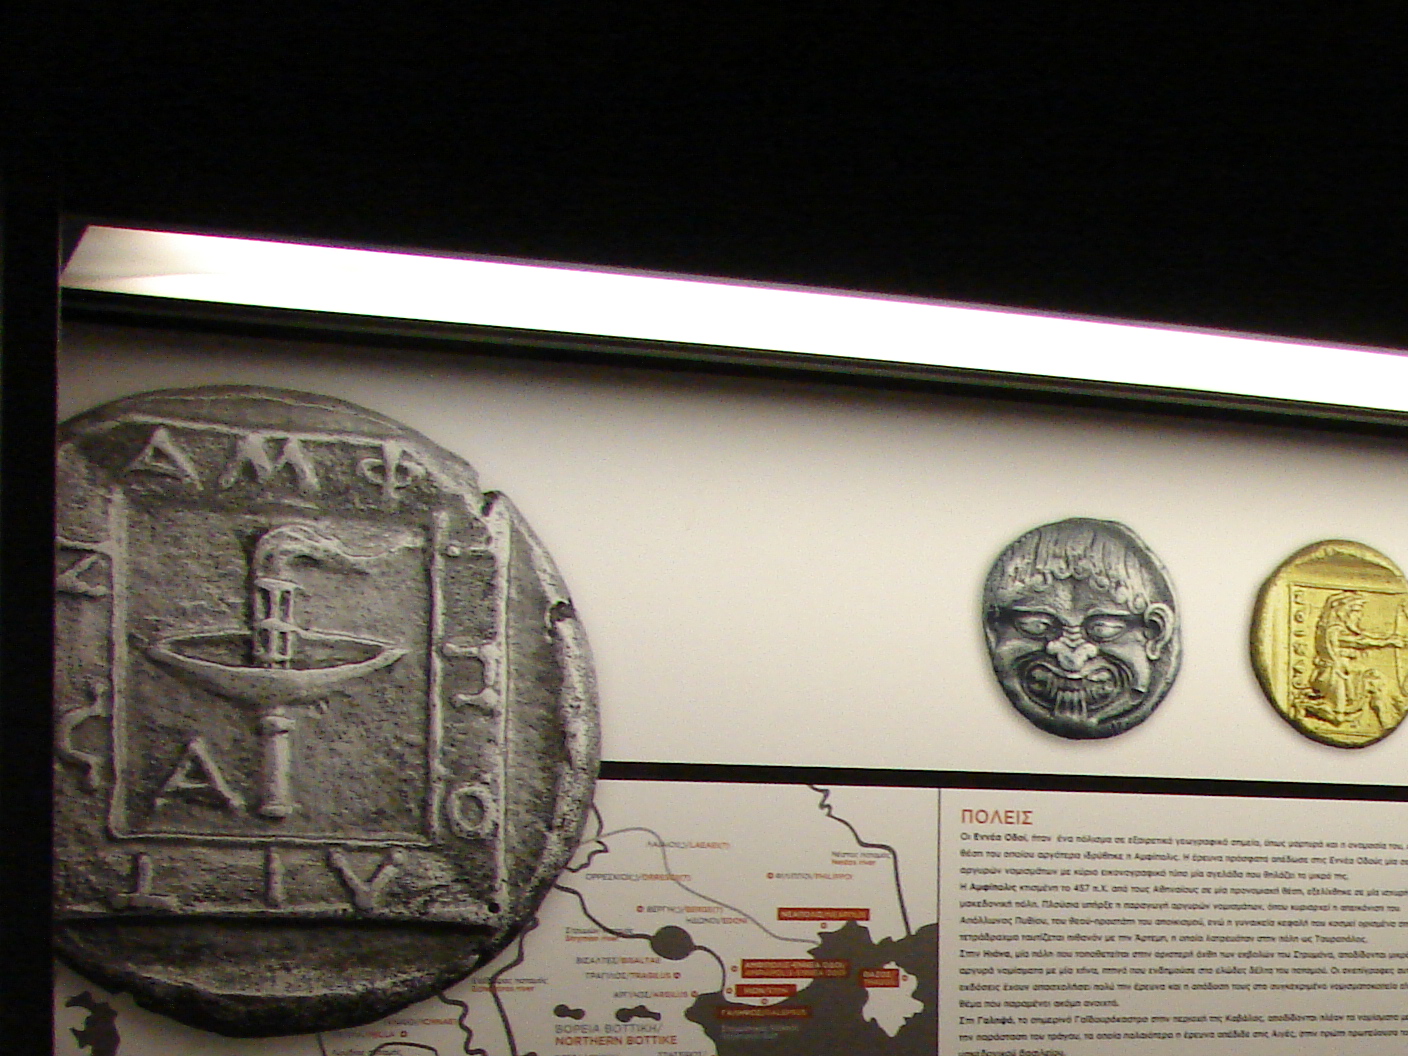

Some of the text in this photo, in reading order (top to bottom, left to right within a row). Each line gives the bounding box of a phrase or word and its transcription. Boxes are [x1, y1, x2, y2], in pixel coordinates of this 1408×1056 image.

[961, 808, 1033, 826] ΠΟΛΕΙΣ
[555, 1024, 600, 1034] ΒΟΡΕΙΑ
[555, 1035, 679, 1046] NORTHERN BOTTIKE
